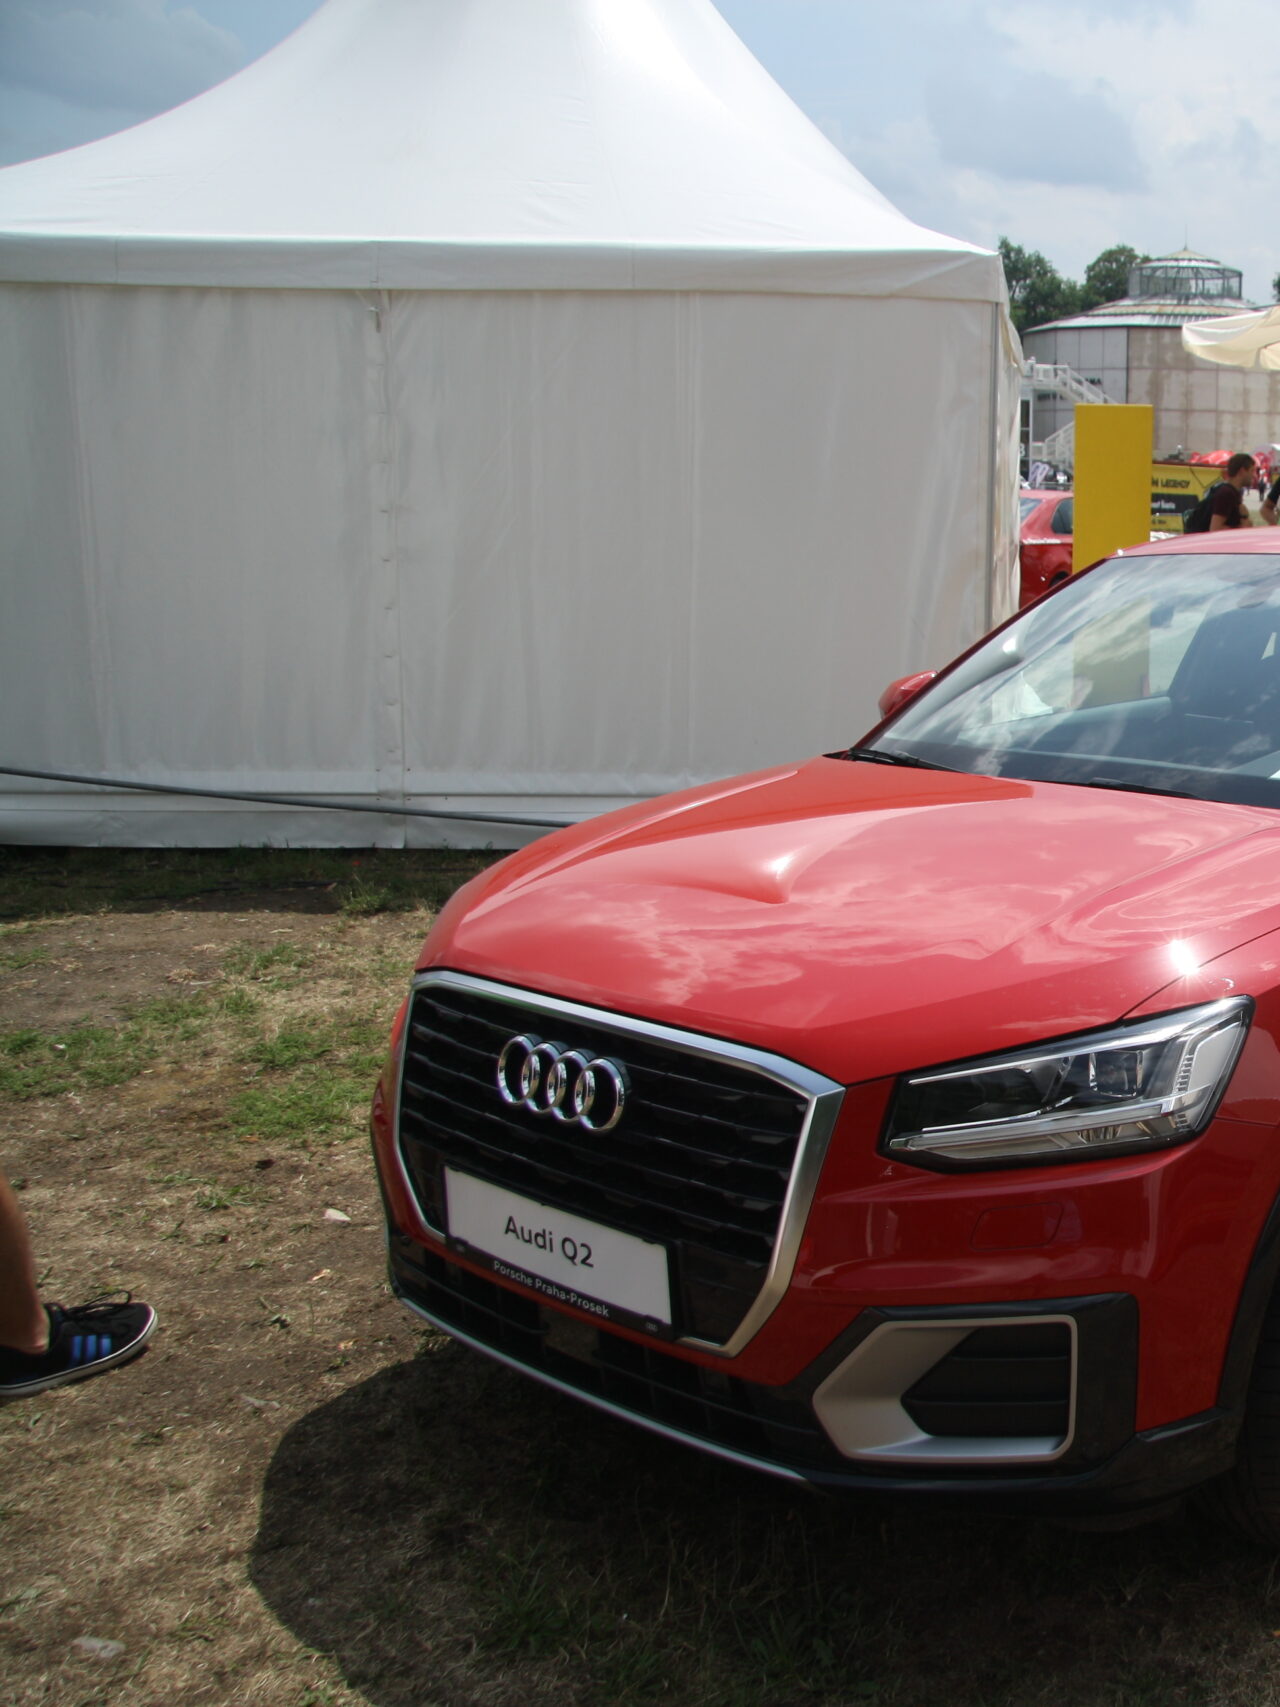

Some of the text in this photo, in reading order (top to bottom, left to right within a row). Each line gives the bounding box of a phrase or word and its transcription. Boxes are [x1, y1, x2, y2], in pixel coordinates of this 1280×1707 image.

[504, 1215, 594, 1268] Audi Q2
[493, 1260, 610, 1318] Porsche Praha-Prosek
